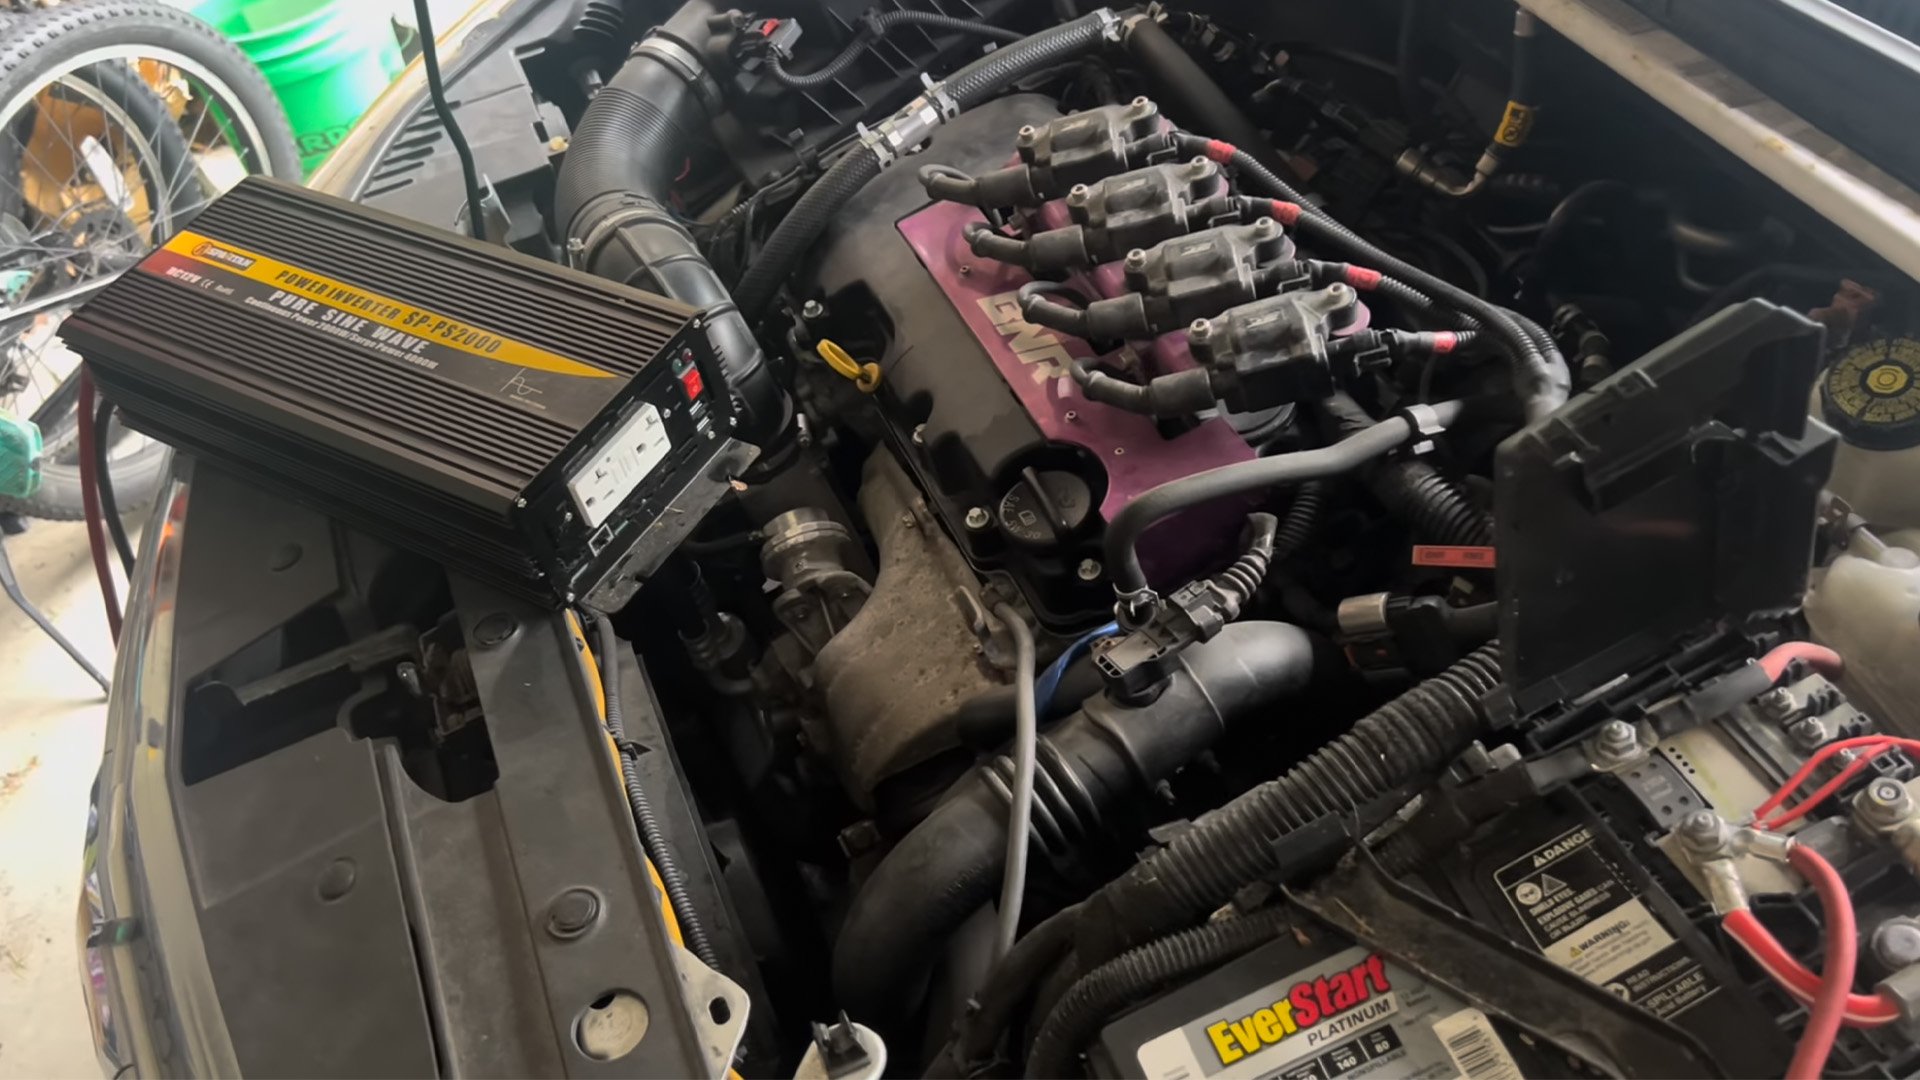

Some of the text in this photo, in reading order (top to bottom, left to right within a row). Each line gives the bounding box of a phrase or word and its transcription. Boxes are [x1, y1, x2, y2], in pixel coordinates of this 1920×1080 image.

[268, 290, 430, 354] PURE SINE WAVE
[275, 270, 502, 353] POWER INVERTER SP-PS2000
[1543, 828, 1594, 860] DANGE
[1206, 953, 1391, 1066] EverStart
[1307, 998, 1391, 1046] PLATINUM
[1336, 1056, 1357, 1070] 140
[1375, 1040, 1390, 1053] 80
